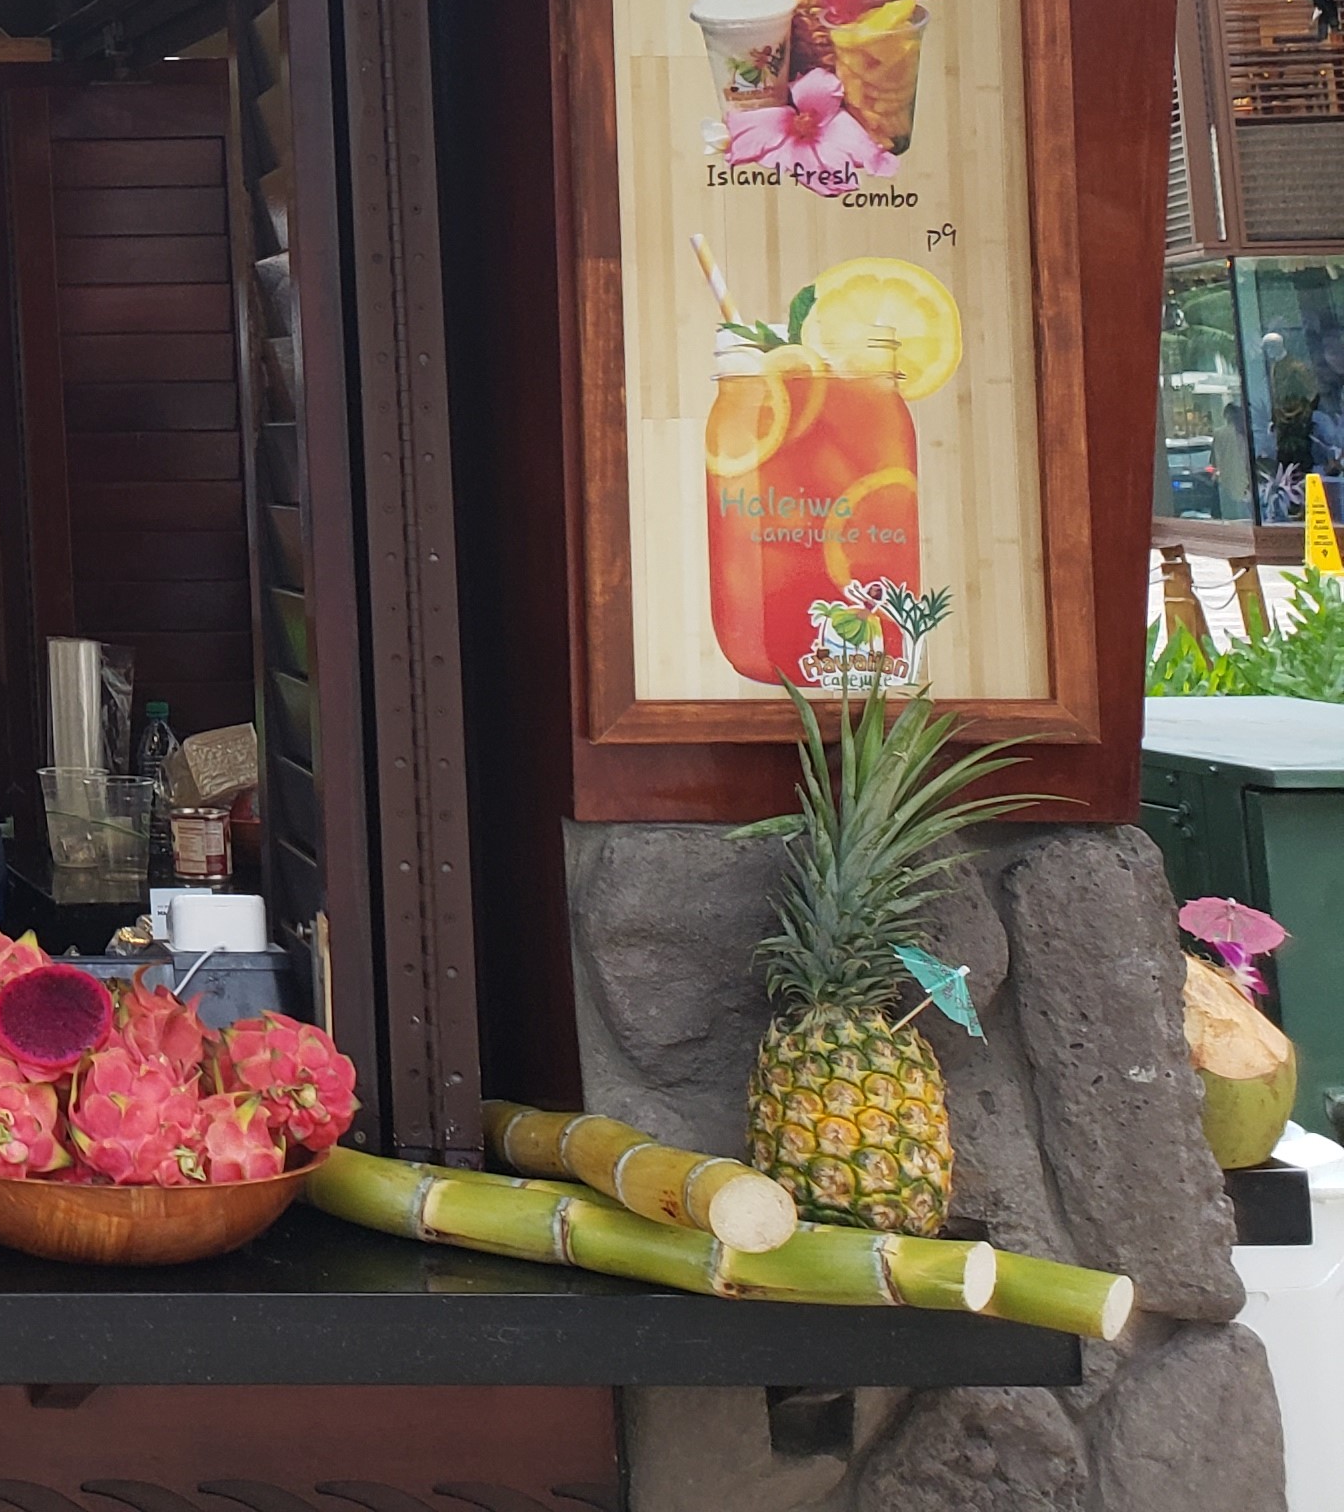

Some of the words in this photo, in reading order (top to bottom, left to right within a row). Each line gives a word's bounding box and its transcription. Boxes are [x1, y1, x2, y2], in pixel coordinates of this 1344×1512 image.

[706, 163, 781, 187] Island
[790, 162, 859, 186] fresh
[842, 185, 919, 208] combo
[720, 487, 853, 519] Haleiwa
[867, 524, 907, 544] tea
